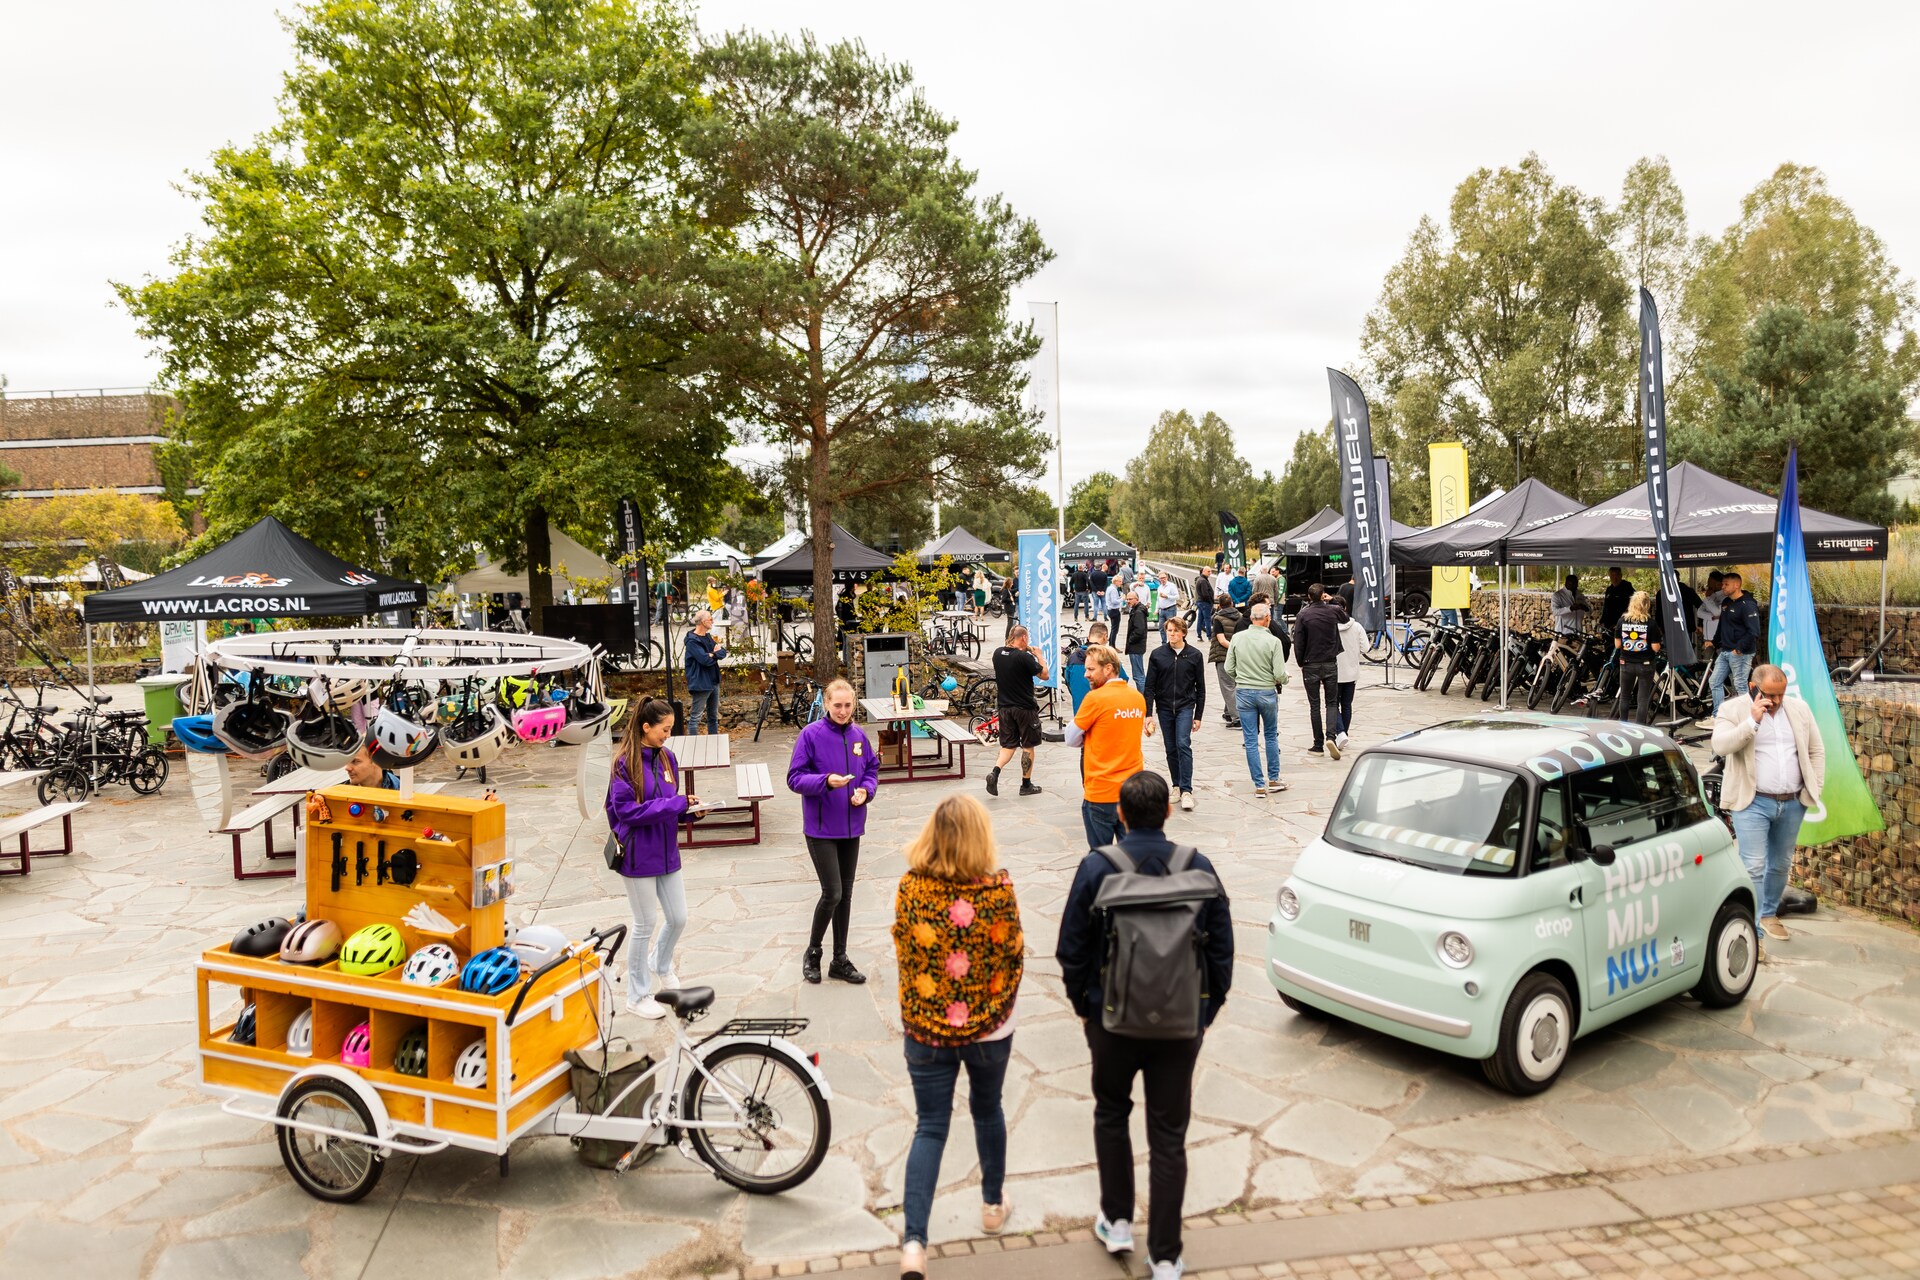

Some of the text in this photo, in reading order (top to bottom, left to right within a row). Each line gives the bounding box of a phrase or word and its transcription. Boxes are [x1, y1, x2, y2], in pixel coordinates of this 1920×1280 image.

[1583, 508, 1652, 518] +STROMER
[1689, 504, 1778, 517] +STROMER
[142, 597, 311, 614] WWW.LACROS.NL
[1359, 861, 1406, 882] drop
[1602, 842, 1685, 904] HUUR
[1349, 918, 1372, 943] FIAT
[1535, 917, 1573, 939] drop
[1607, 894, 1659, 950] MIJ
[1607, 937, 1659, 997] NU!
